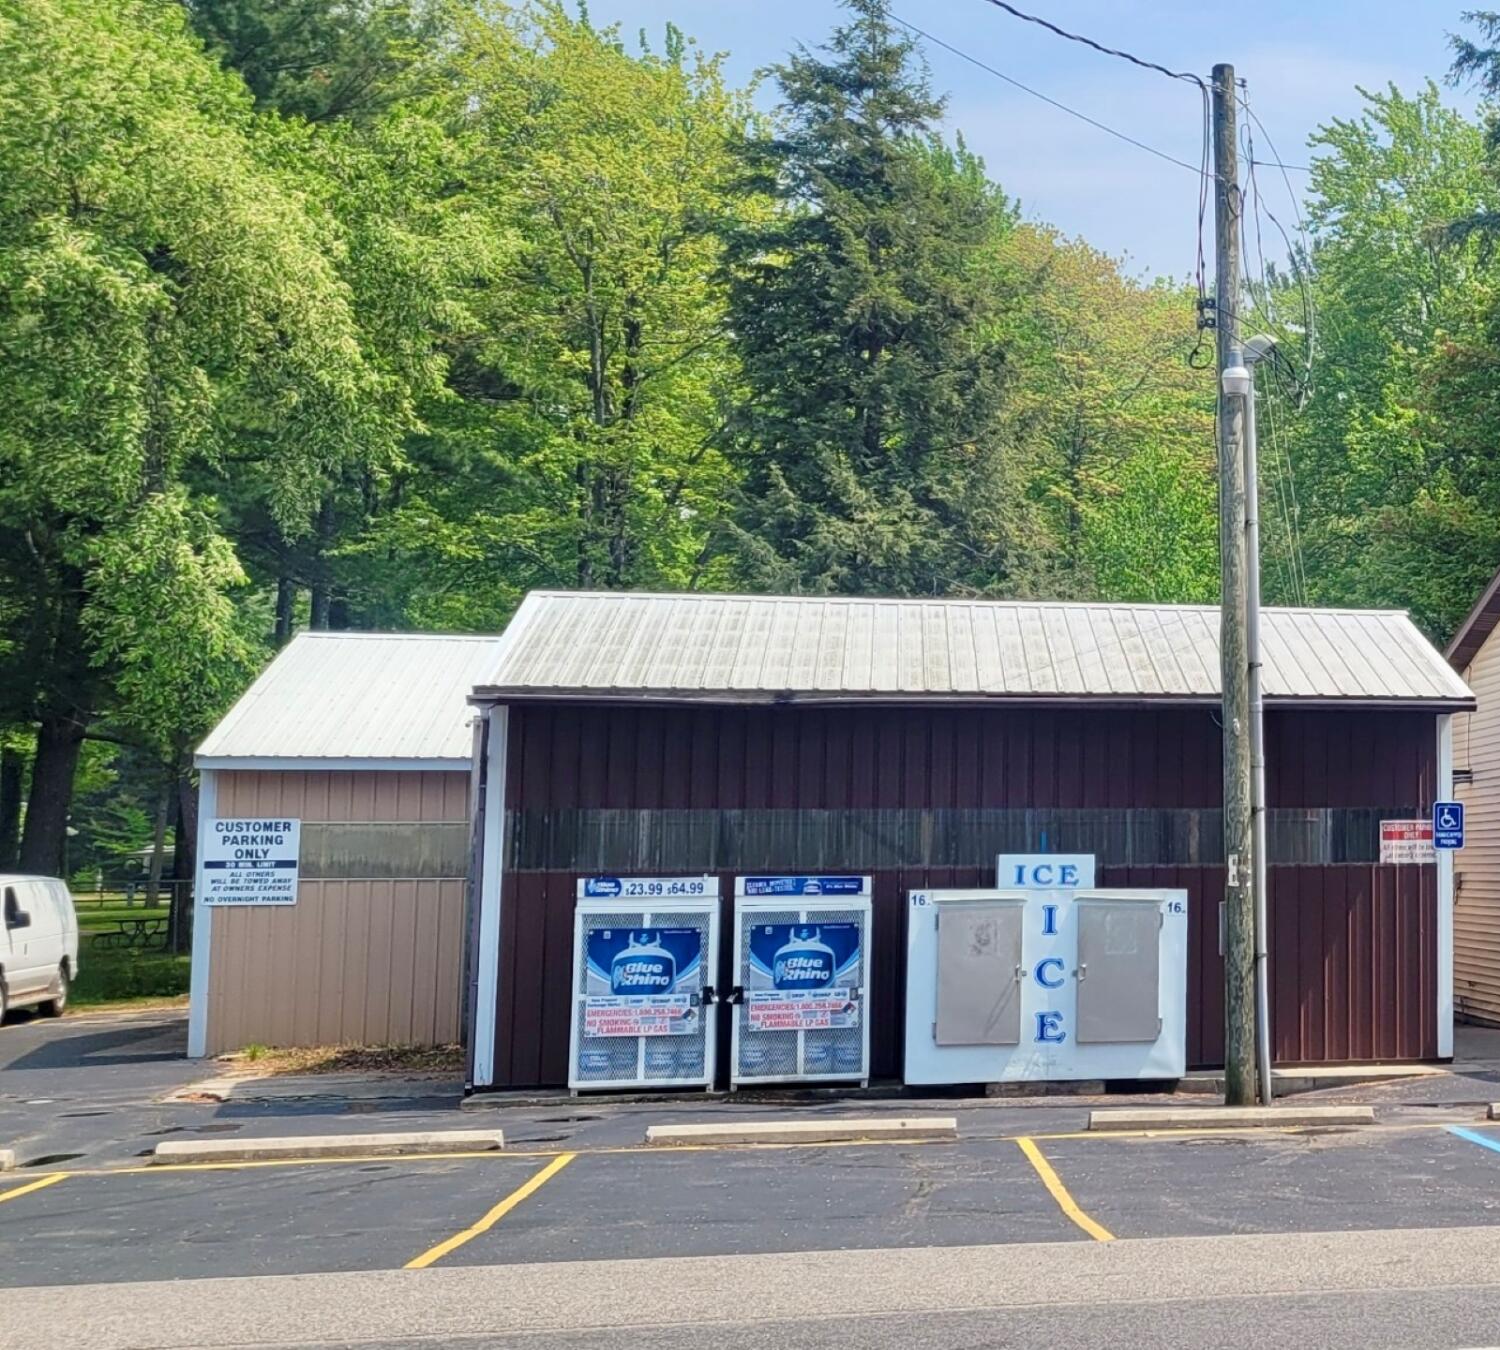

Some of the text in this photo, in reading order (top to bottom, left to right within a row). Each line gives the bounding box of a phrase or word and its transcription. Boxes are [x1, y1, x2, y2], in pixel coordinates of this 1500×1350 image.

[215, 821, 292, 833] CUSTOMER
[222, 835, 284, 846] PARKING
[234, 848, 270, 860] ONLY
[1014, 864, 1080, 886] ICE
[625, 883, 663, 896] $23.99
[667, 881, 704, 895] $64.99
[625, 962, 663, 974] Blue
[787, 957, 823, 969] Blue
[1033, 904, 1066, 1044] ICE
